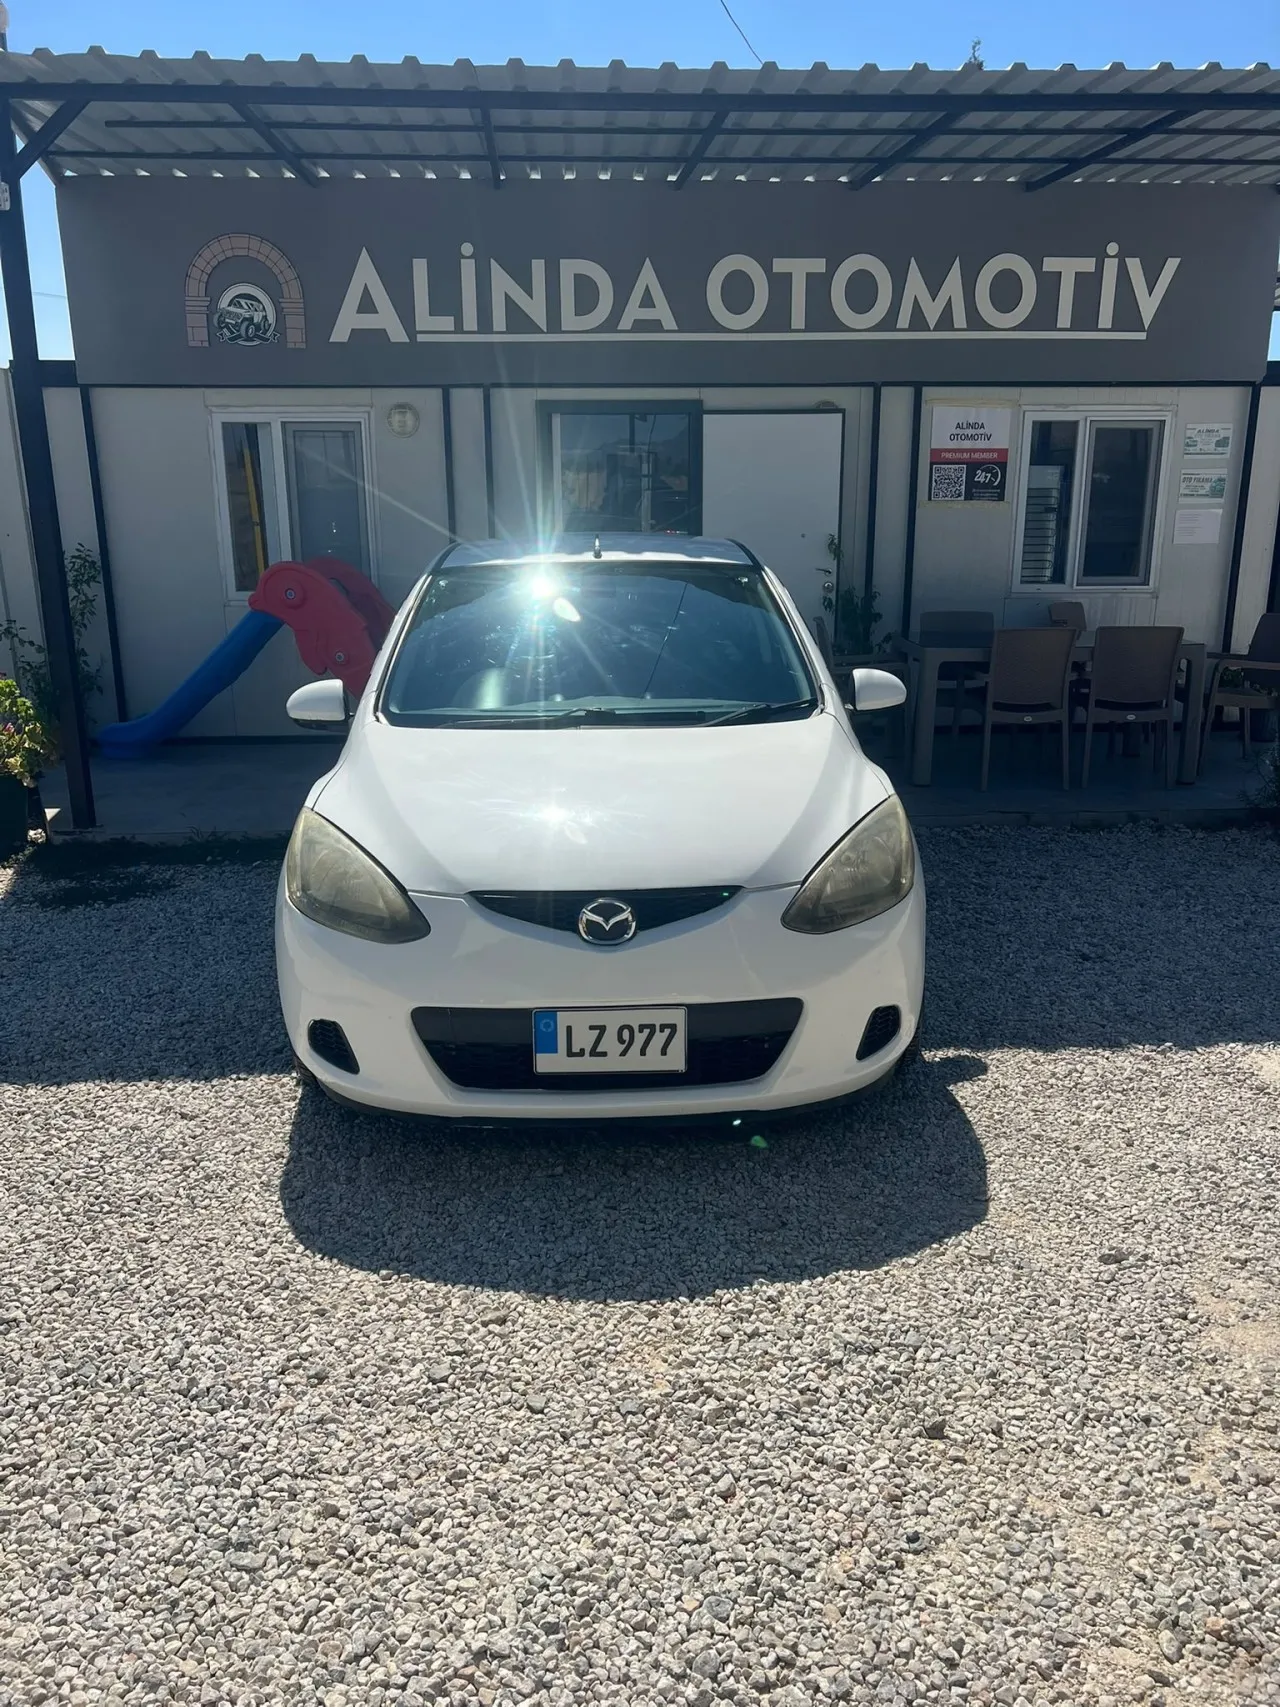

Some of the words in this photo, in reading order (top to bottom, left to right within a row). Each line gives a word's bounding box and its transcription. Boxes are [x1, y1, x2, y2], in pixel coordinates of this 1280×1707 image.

[329, 242, 679, 342] ALİNDA
[706, 242, 1182, 330] OTOMOTİV
[955, 421, 985, 430] ALİNDA
[949, 432, 992, 441] OTOMOTİV
[566, 1024, 608, 1057] LZ
[617, 1023, 678, 1057] 977
